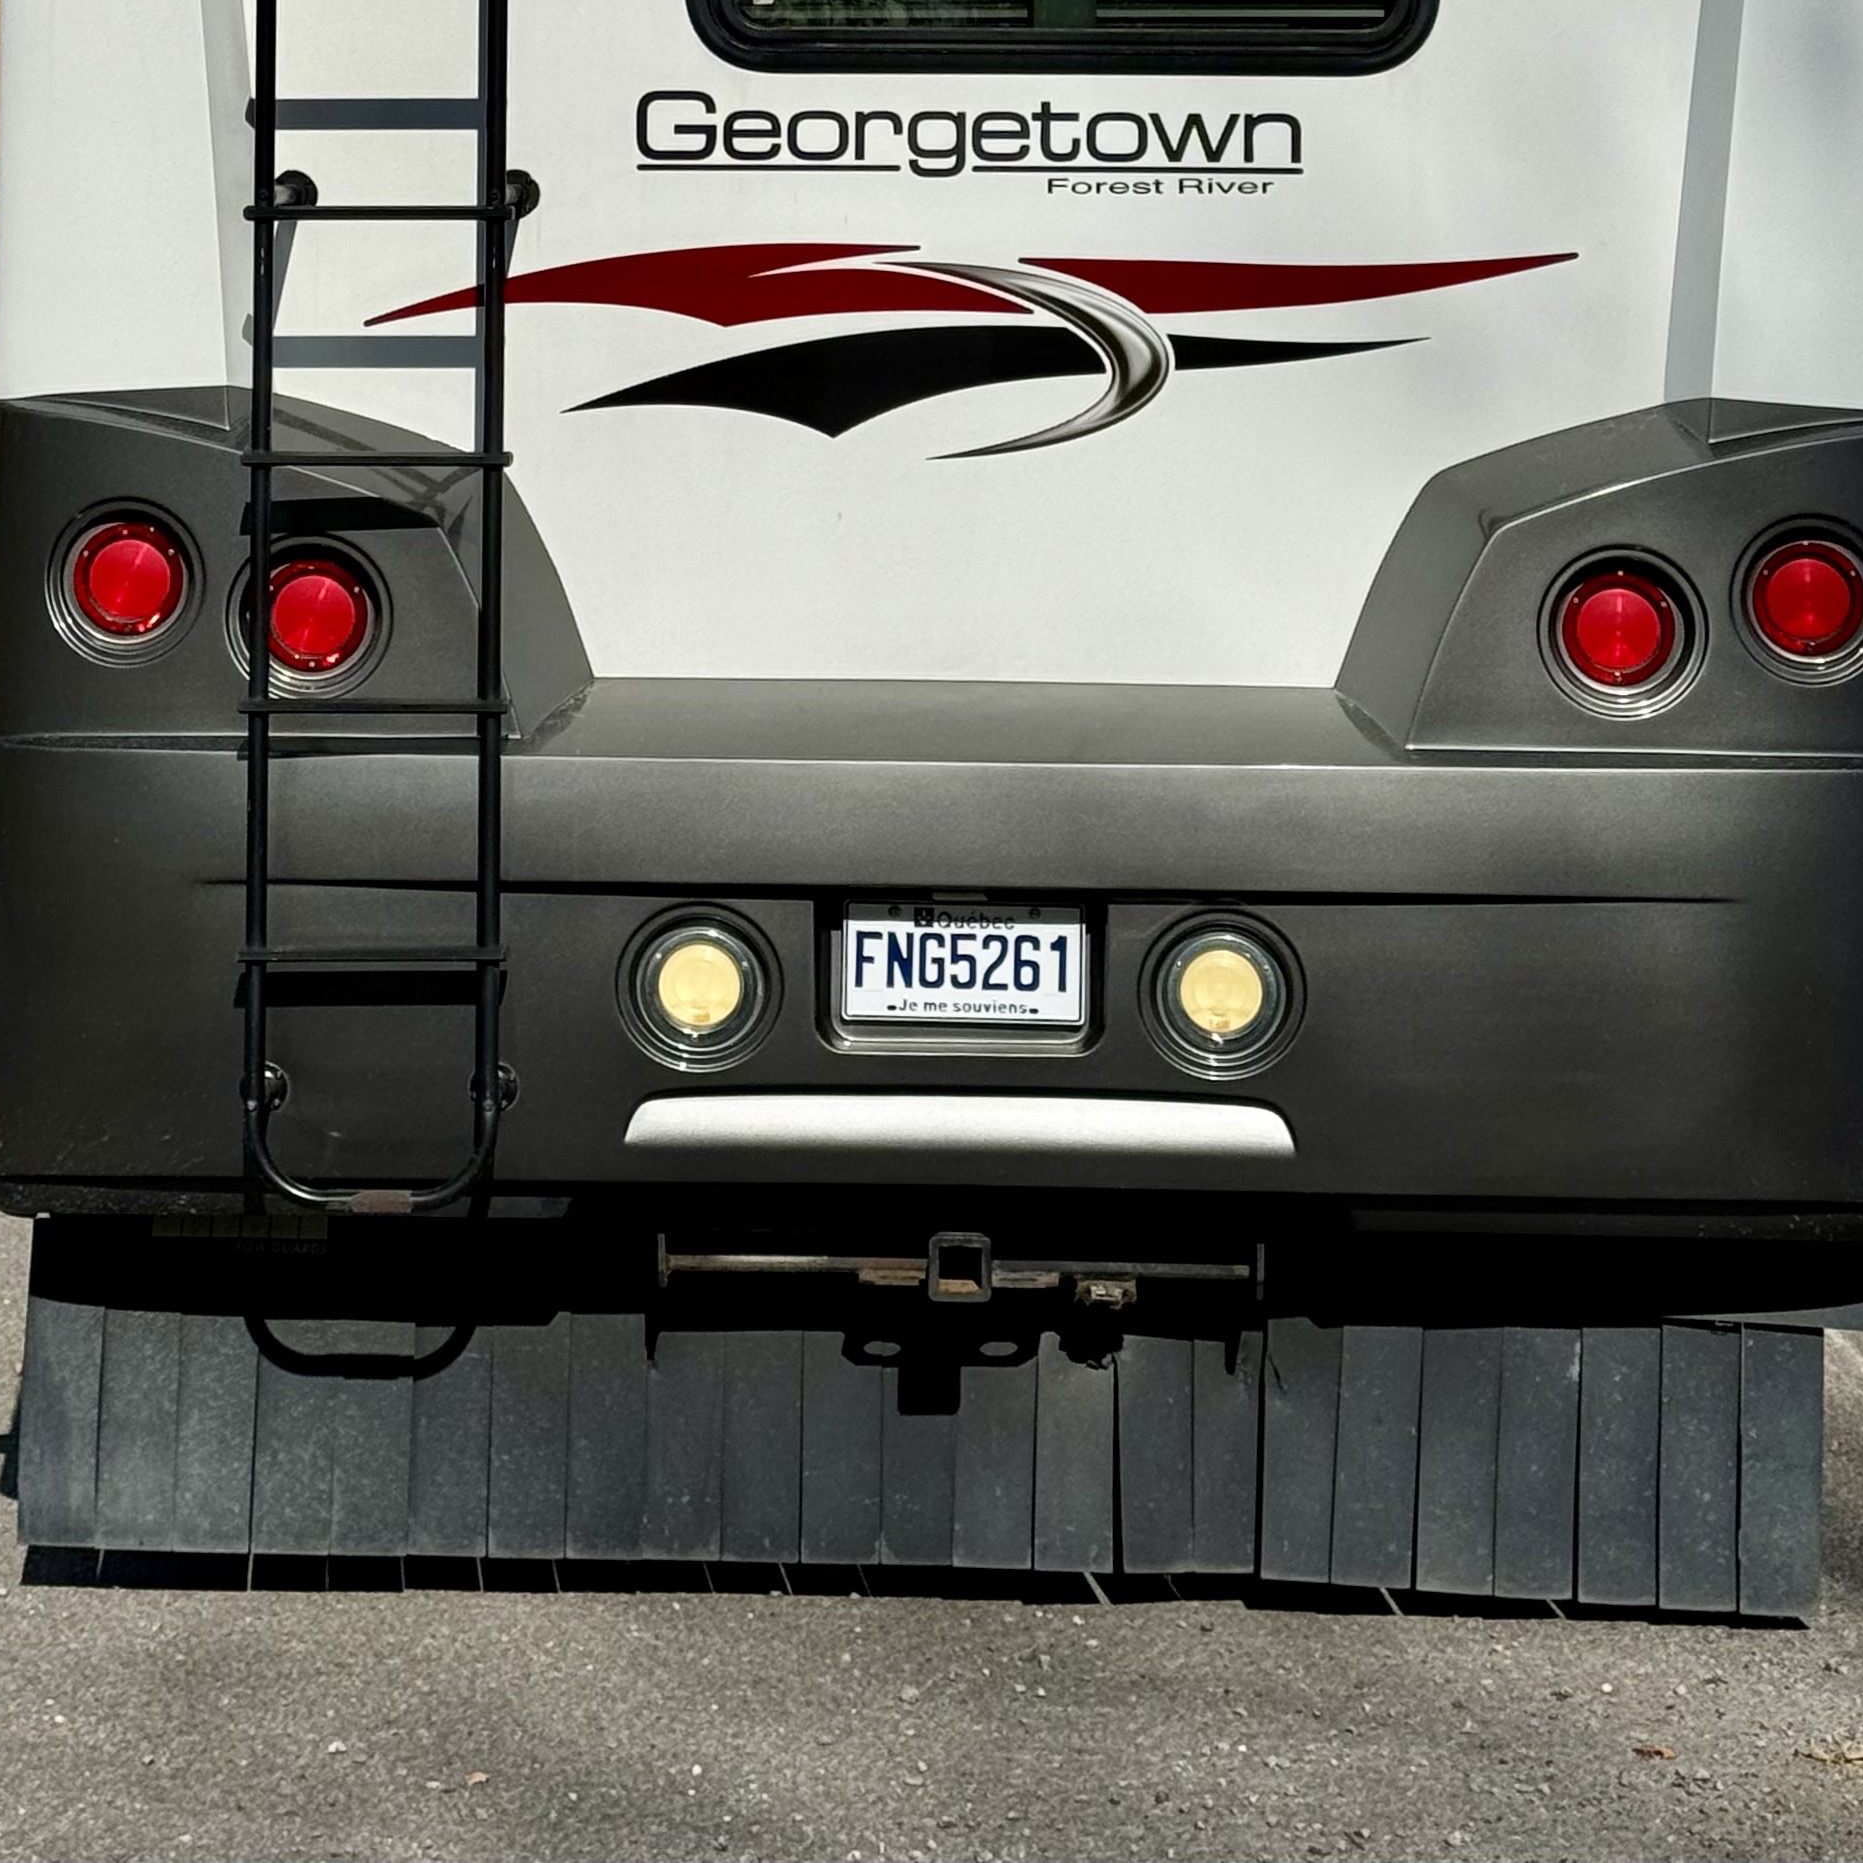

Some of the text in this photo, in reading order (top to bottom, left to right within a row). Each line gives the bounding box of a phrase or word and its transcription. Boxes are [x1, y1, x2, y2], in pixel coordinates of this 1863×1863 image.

[636, 90, 1303, 178] Georgetown
[1046, 178, 1275, 195] Forest River
[937, 910, 1016, 930] Québec
[854, 930, 1068, 993] FNG5261
[899, 998, 1028, 1015] Je me souviens
